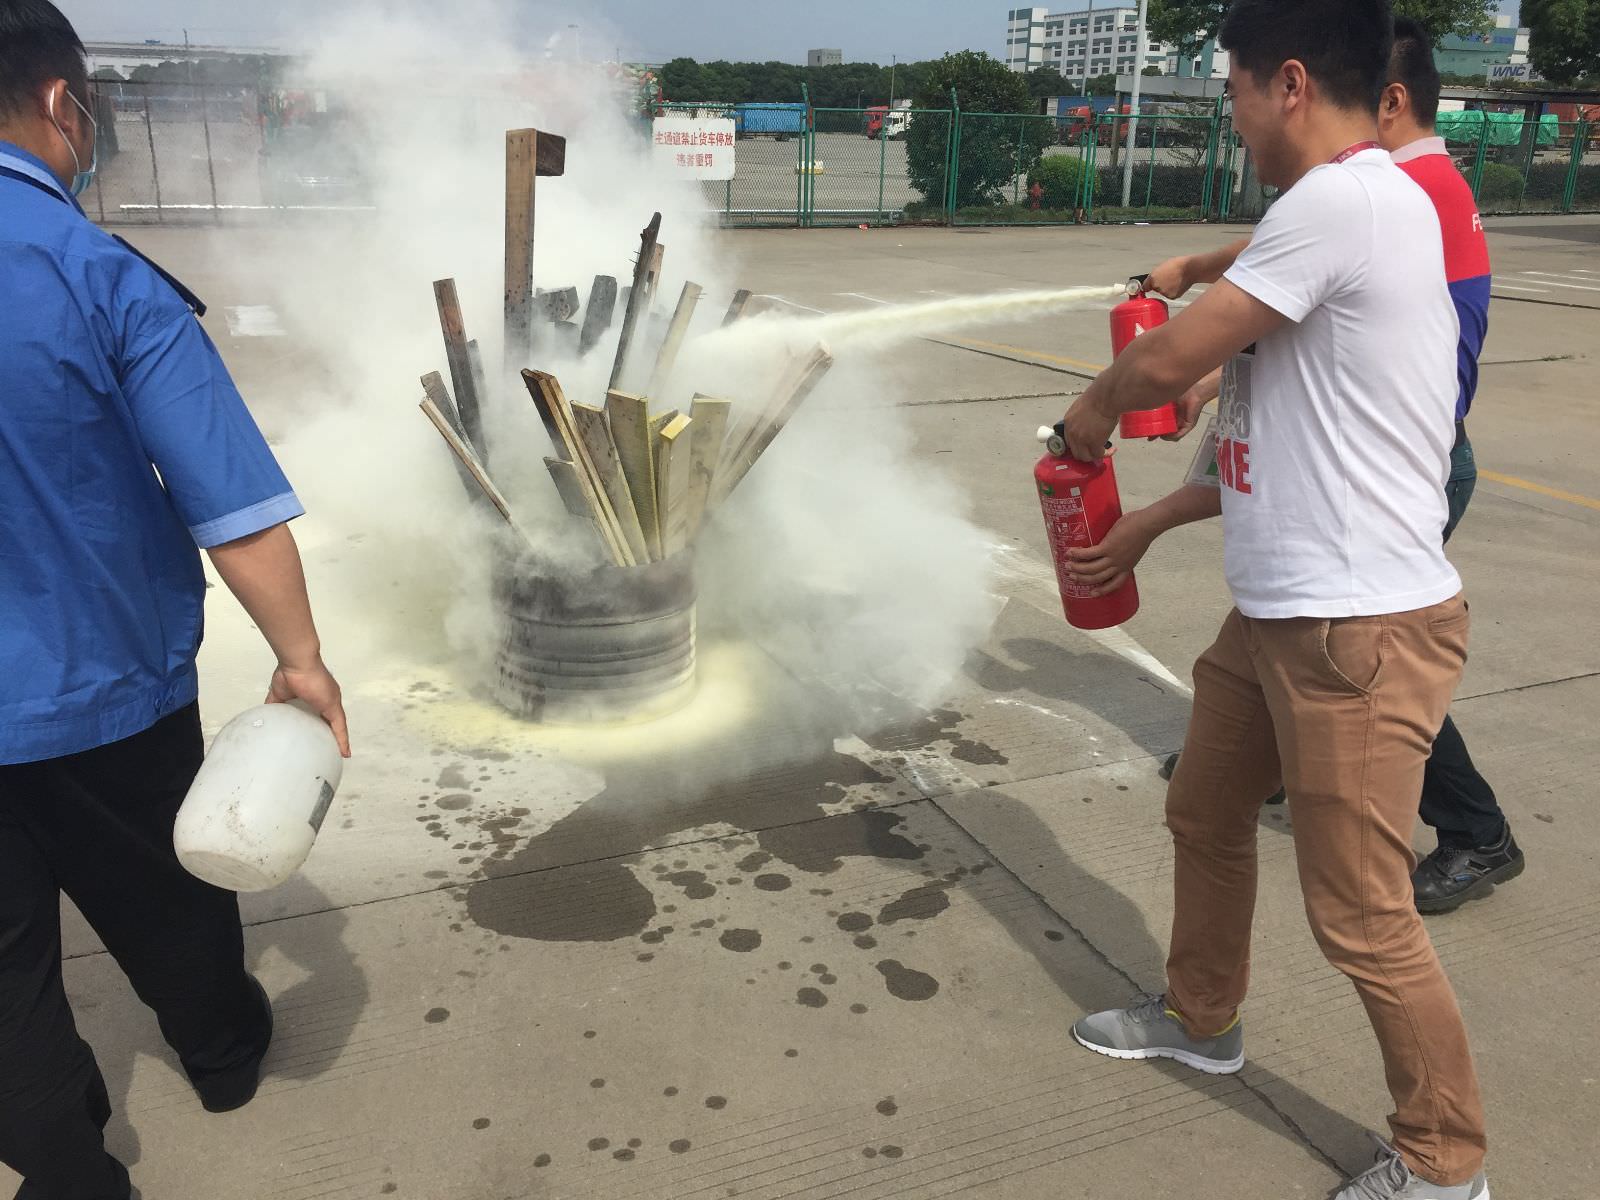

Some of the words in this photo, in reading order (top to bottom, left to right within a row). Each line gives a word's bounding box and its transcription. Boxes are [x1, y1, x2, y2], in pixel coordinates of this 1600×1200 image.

[1493, 66, 1526, 77] WNC
[655, 131, 733, 147] 主通道禁止货车停放
[676, 153, 713, 167] 违者重罚
